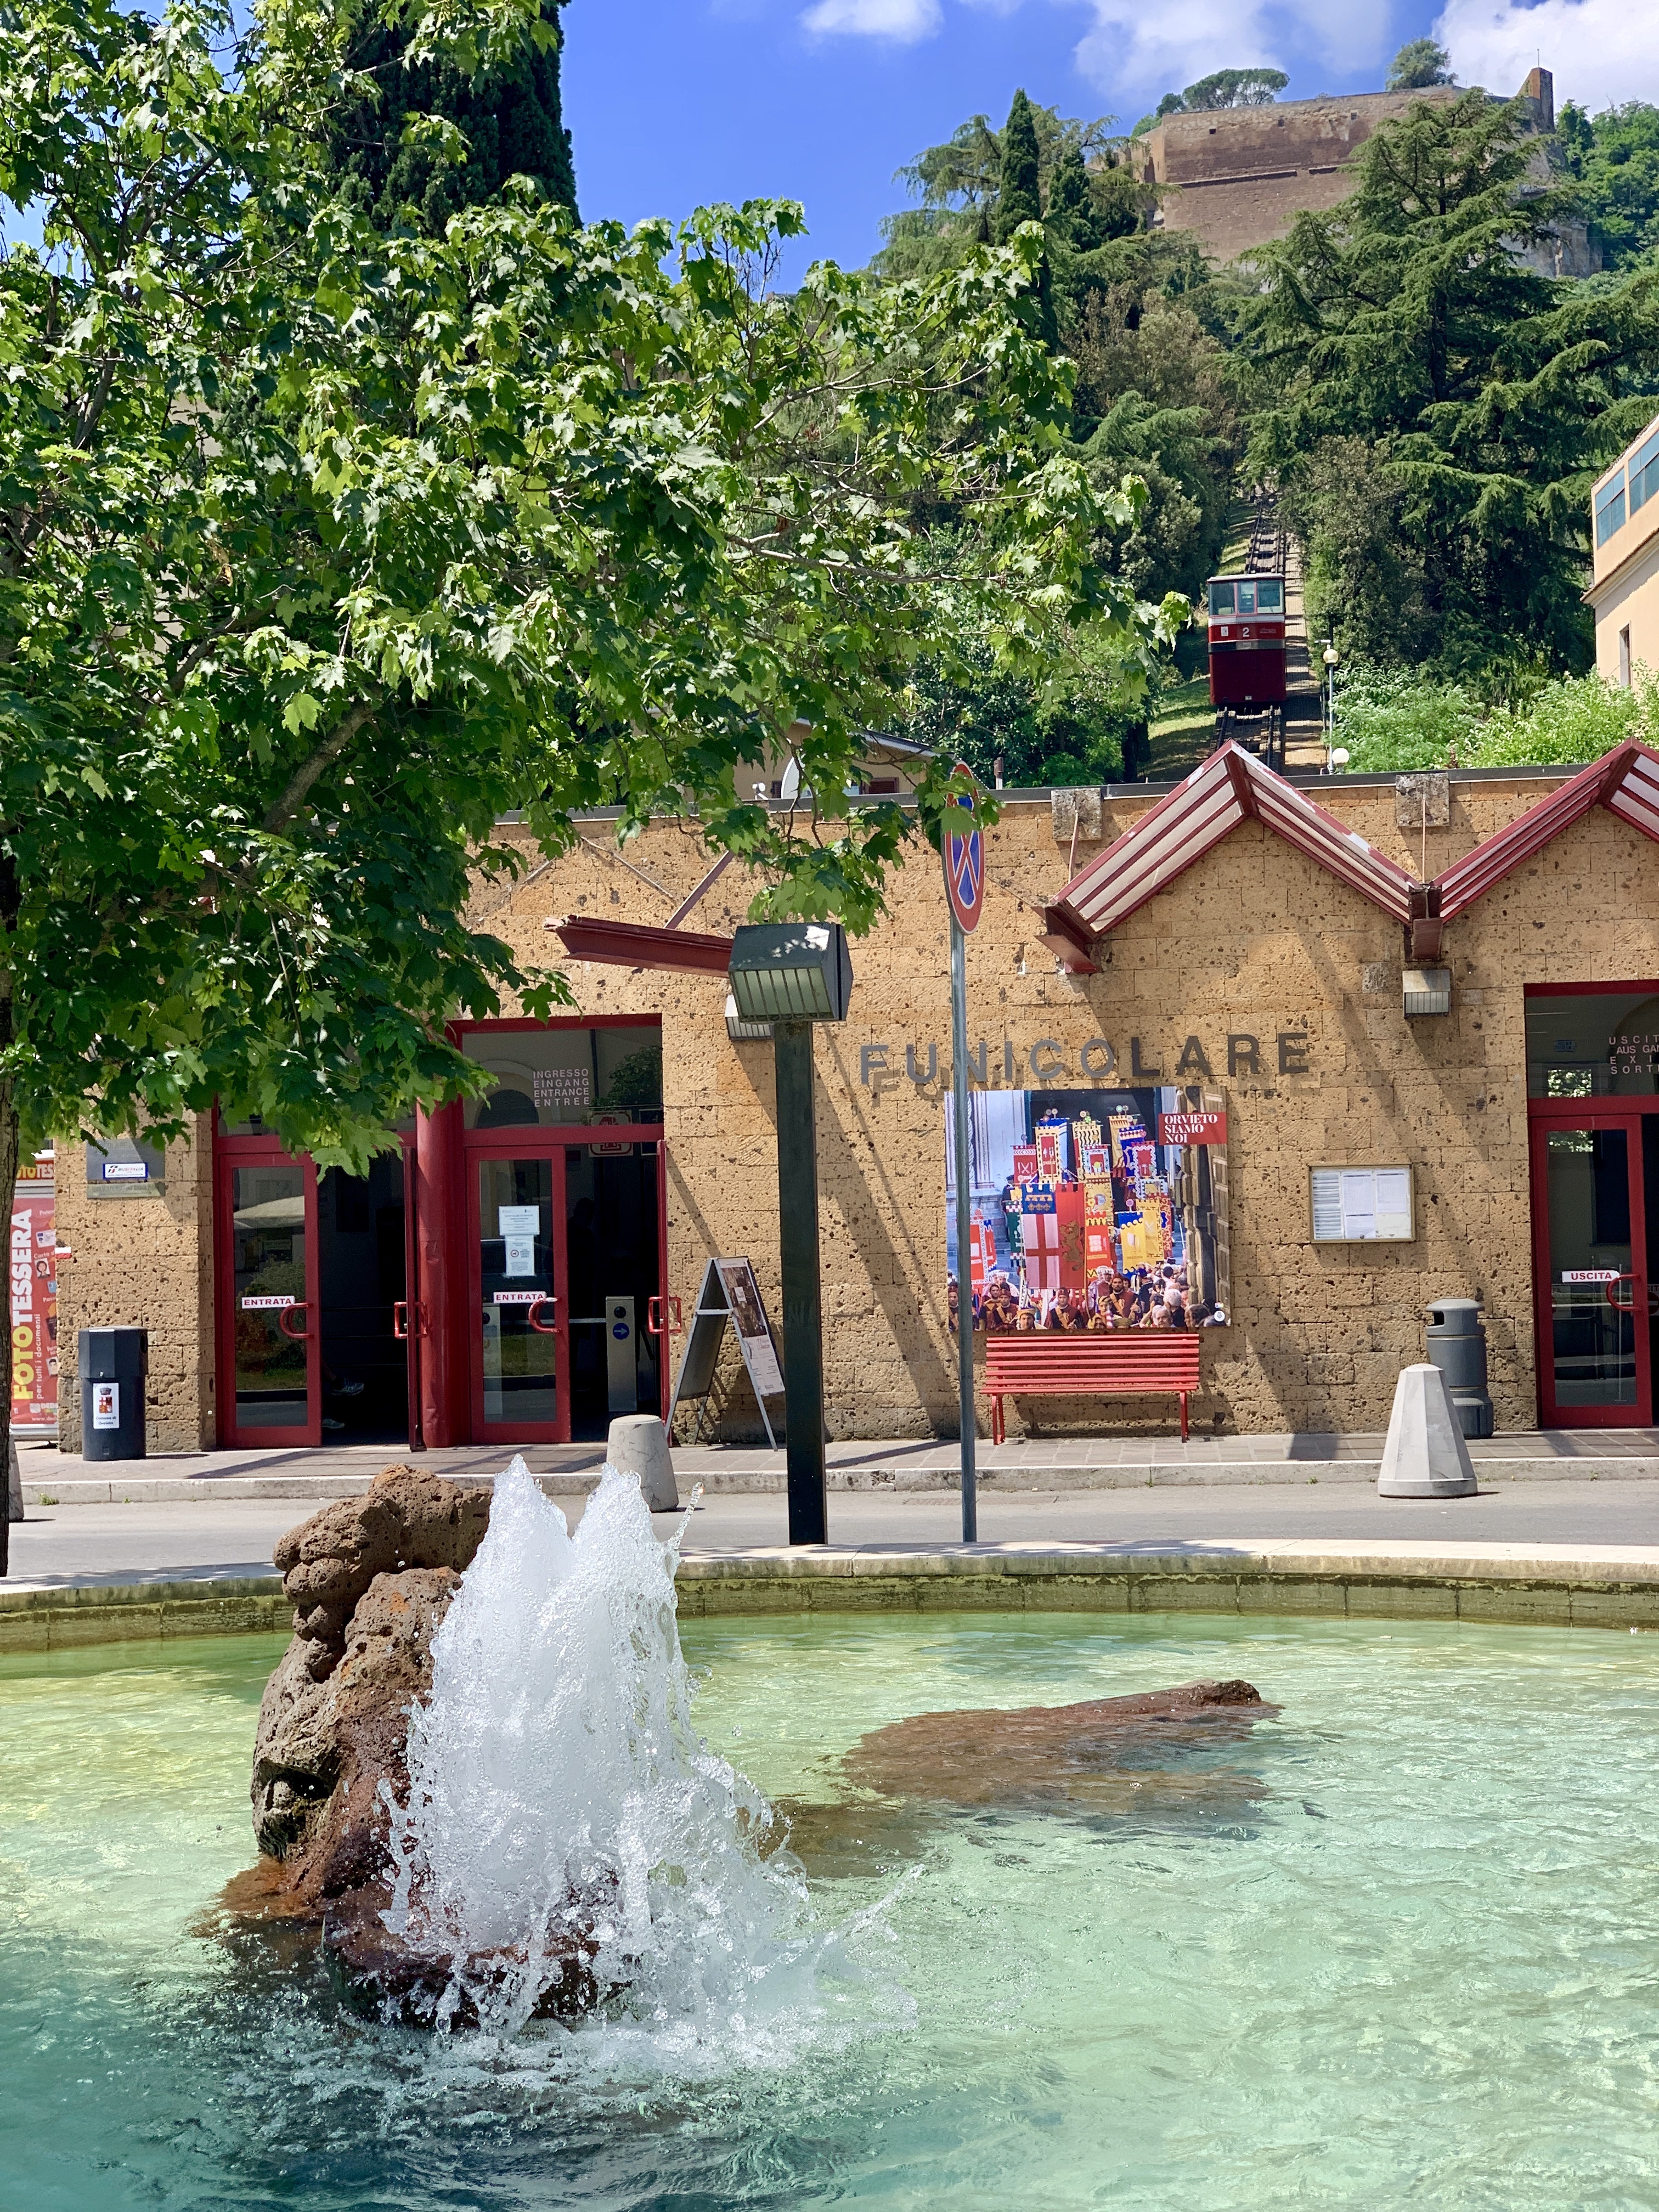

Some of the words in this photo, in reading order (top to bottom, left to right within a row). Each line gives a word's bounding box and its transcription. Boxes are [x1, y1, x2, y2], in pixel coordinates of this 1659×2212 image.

[1243, 627, 1250, 637] 2
[1617, 1046, 1636, 1054] AUS
[860, 1032, 1310, 1085] FUNICOLARE
[533, 1068, 589, 1079] INGRESSO
[534, 1078, 589, 1088] EINGANG
[534, 1087, 590, 1098] ENTRANCE
[534, 1097, 590, 1108] ENTREE
[1164, 1114, 1218, 1124] ORVIETO
[1164, 1124, 1204, 1134] SIAMO
[1165, 1133, 1188, 1143] NOI
[1571, 1272, 1612, 1280] USCITA
[11, 1209, 34, 1400] FOTOTESSERA
[33, 1314, 42, 1358] documenti
